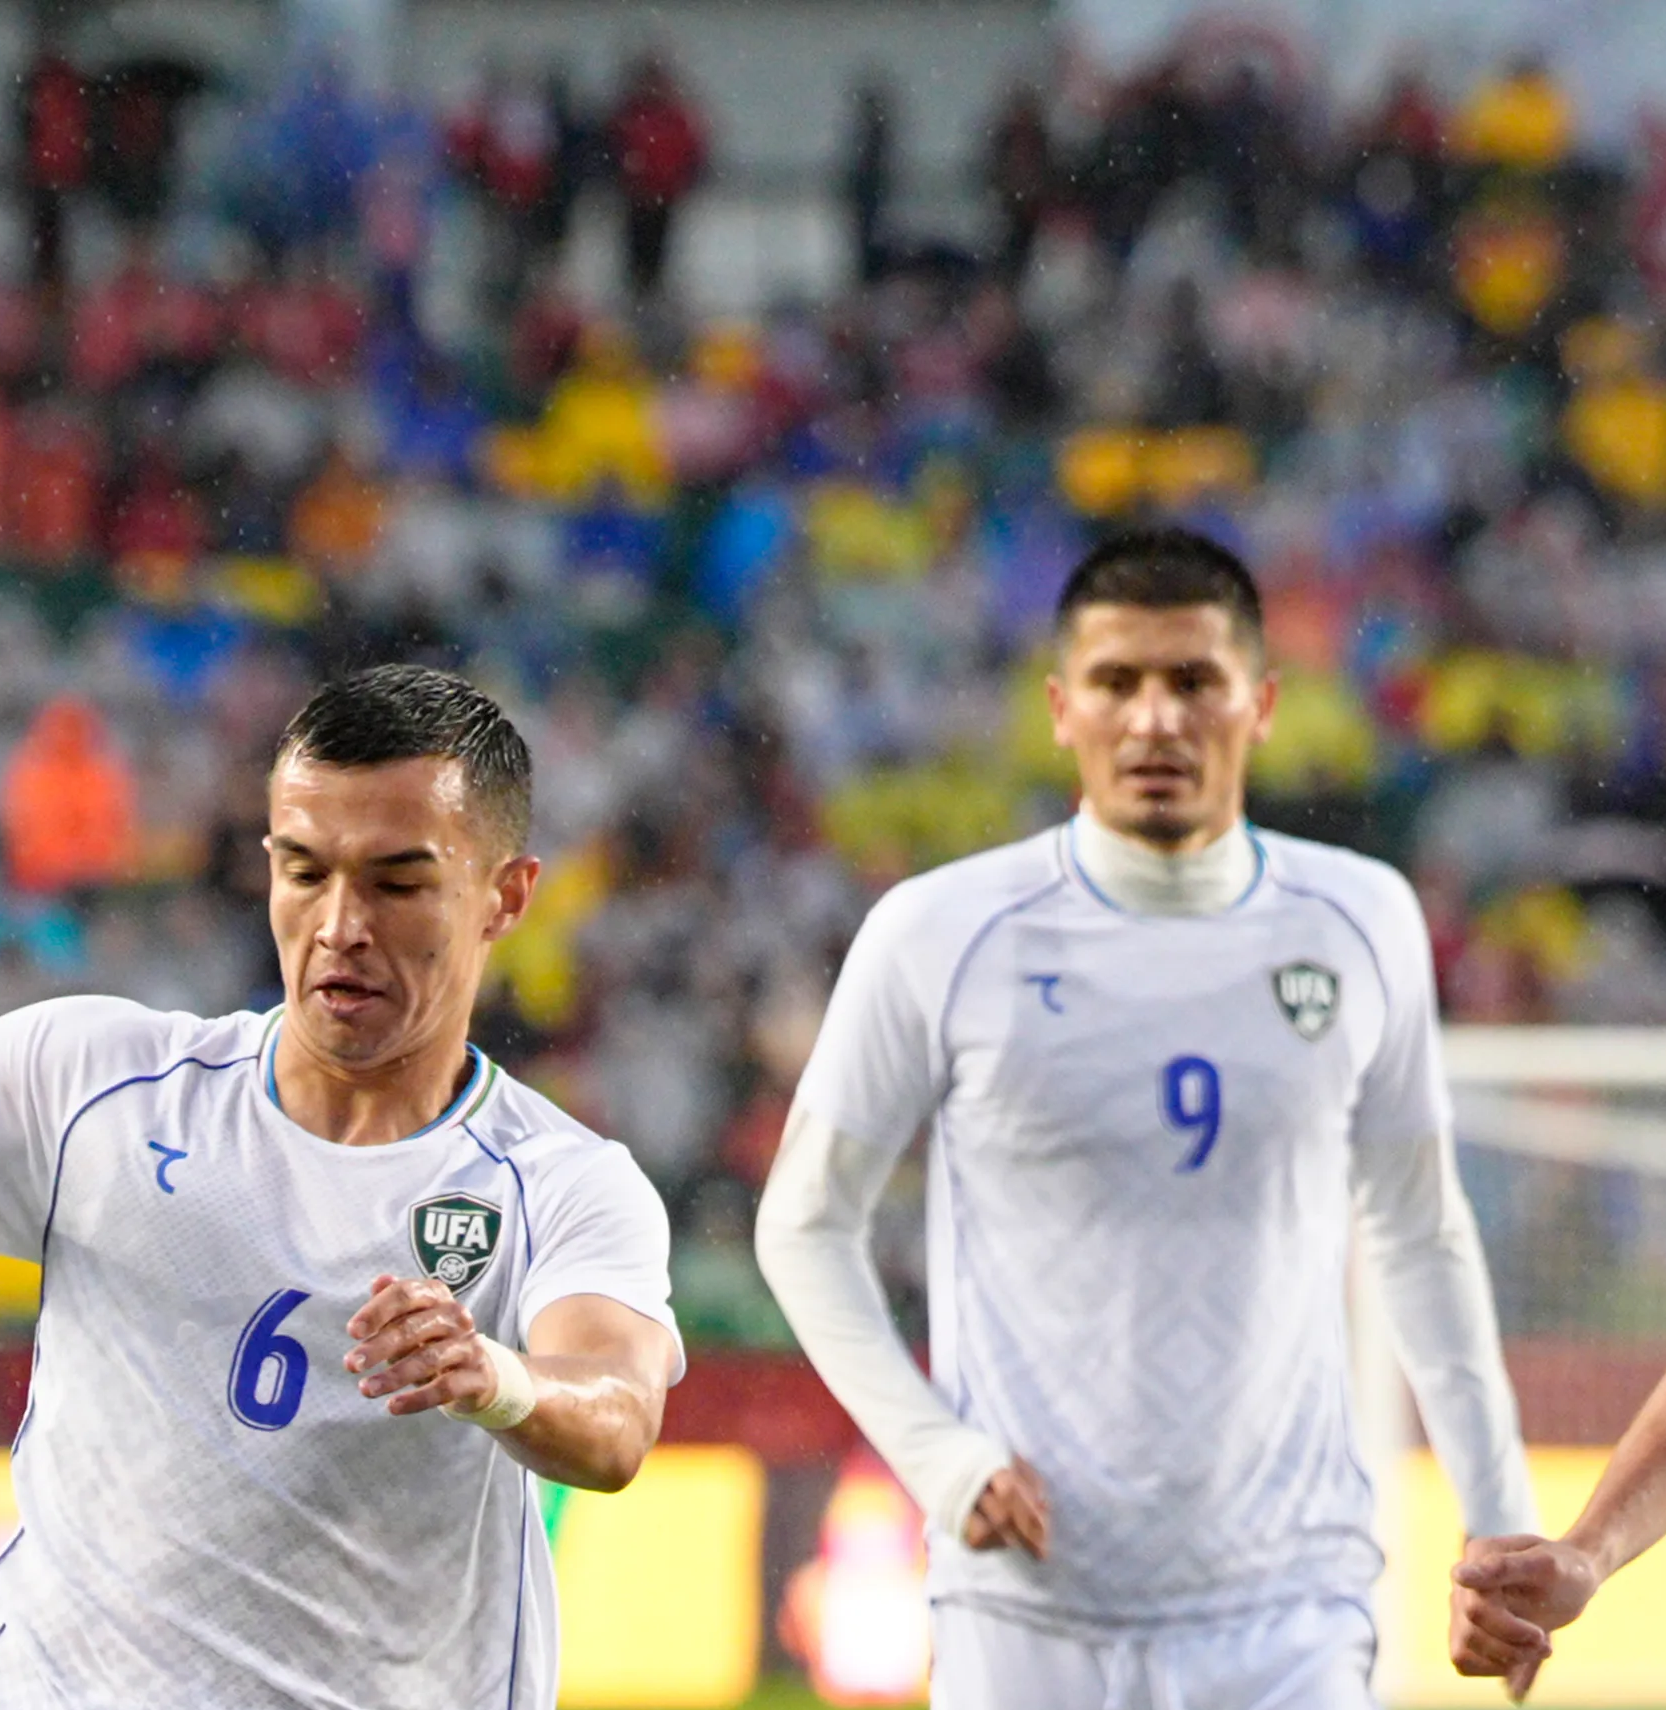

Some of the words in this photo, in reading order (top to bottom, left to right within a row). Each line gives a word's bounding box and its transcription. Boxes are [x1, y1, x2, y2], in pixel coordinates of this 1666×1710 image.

[1158, 1055, 1222, 1174] 9
[423, 1211, 489, 1250] UFA
[227, 1288, 312, 1431] 6
